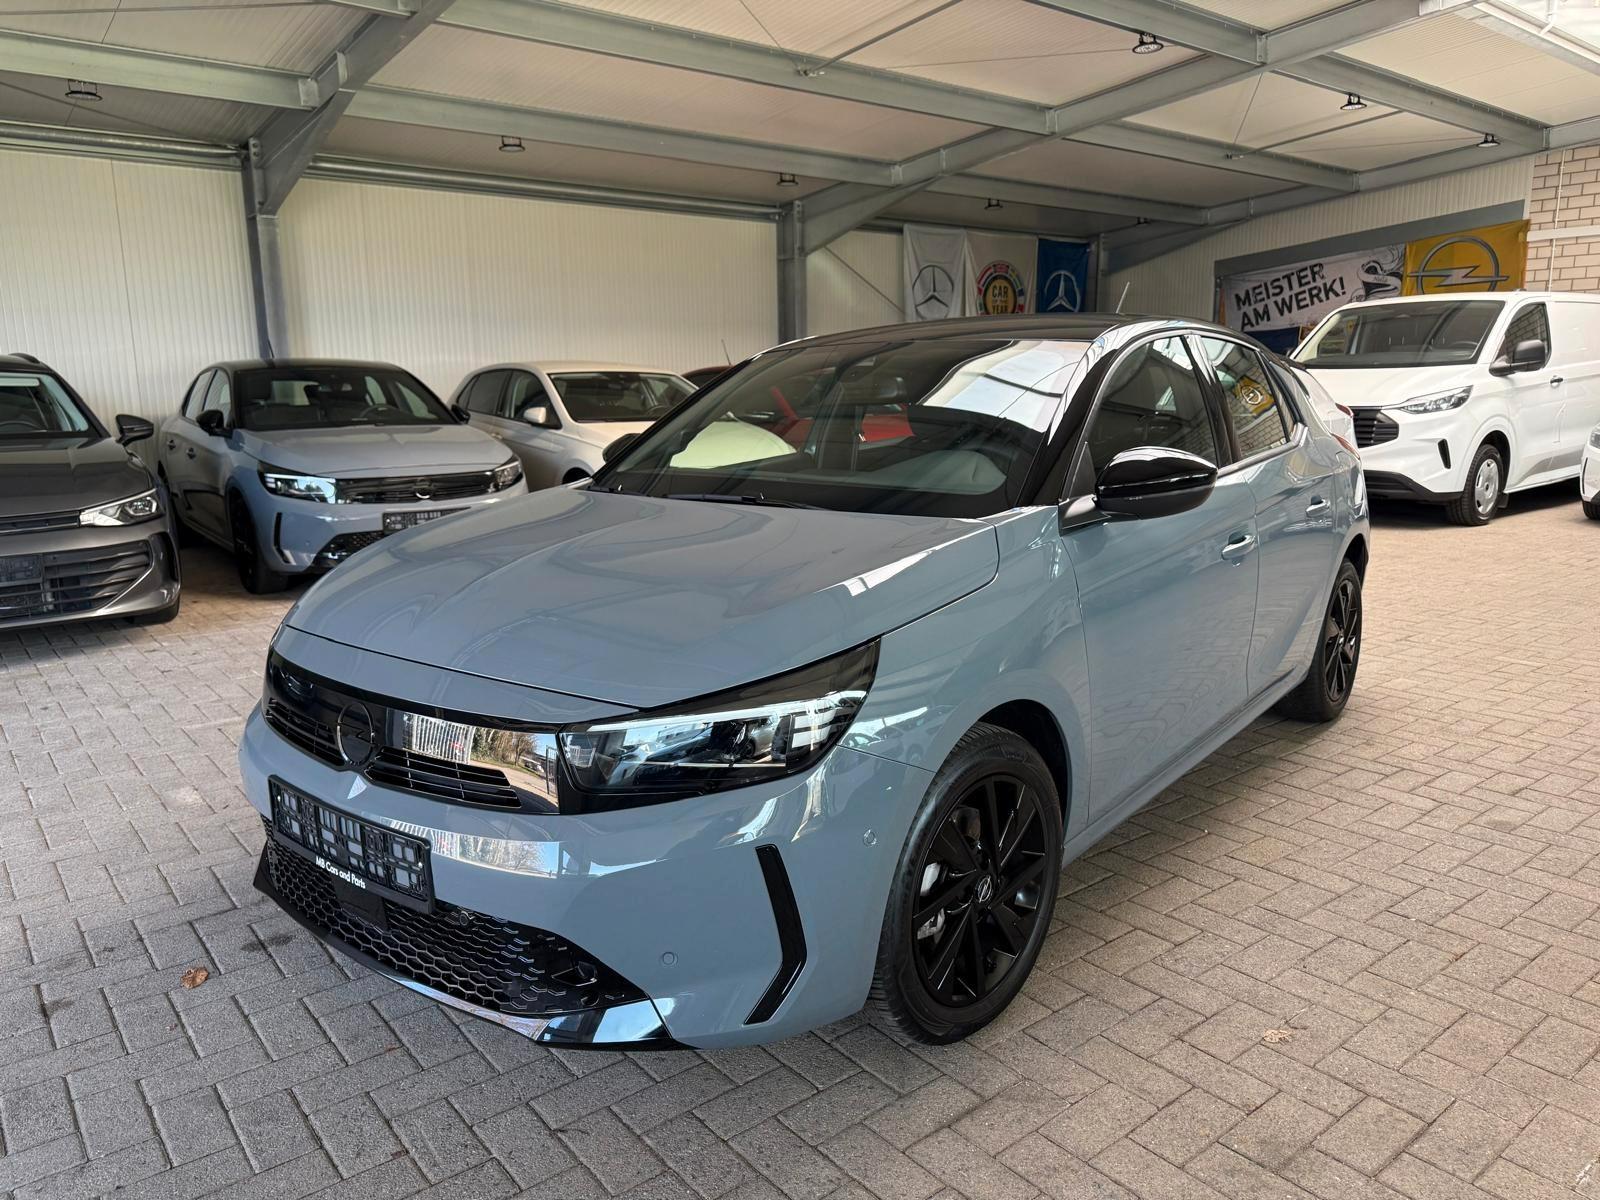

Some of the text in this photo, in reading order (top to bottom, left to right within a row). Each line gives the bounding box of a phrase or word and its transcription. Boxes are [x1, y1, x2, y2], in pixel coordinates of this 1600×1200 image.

[992, 284, 1008, 298] CAR
[1234, 262, 1325, 311] MEISTER
[1241, 276, 1346, 332] AM WERK!
[315, 855, 366, 889] MB Cars and Parts
